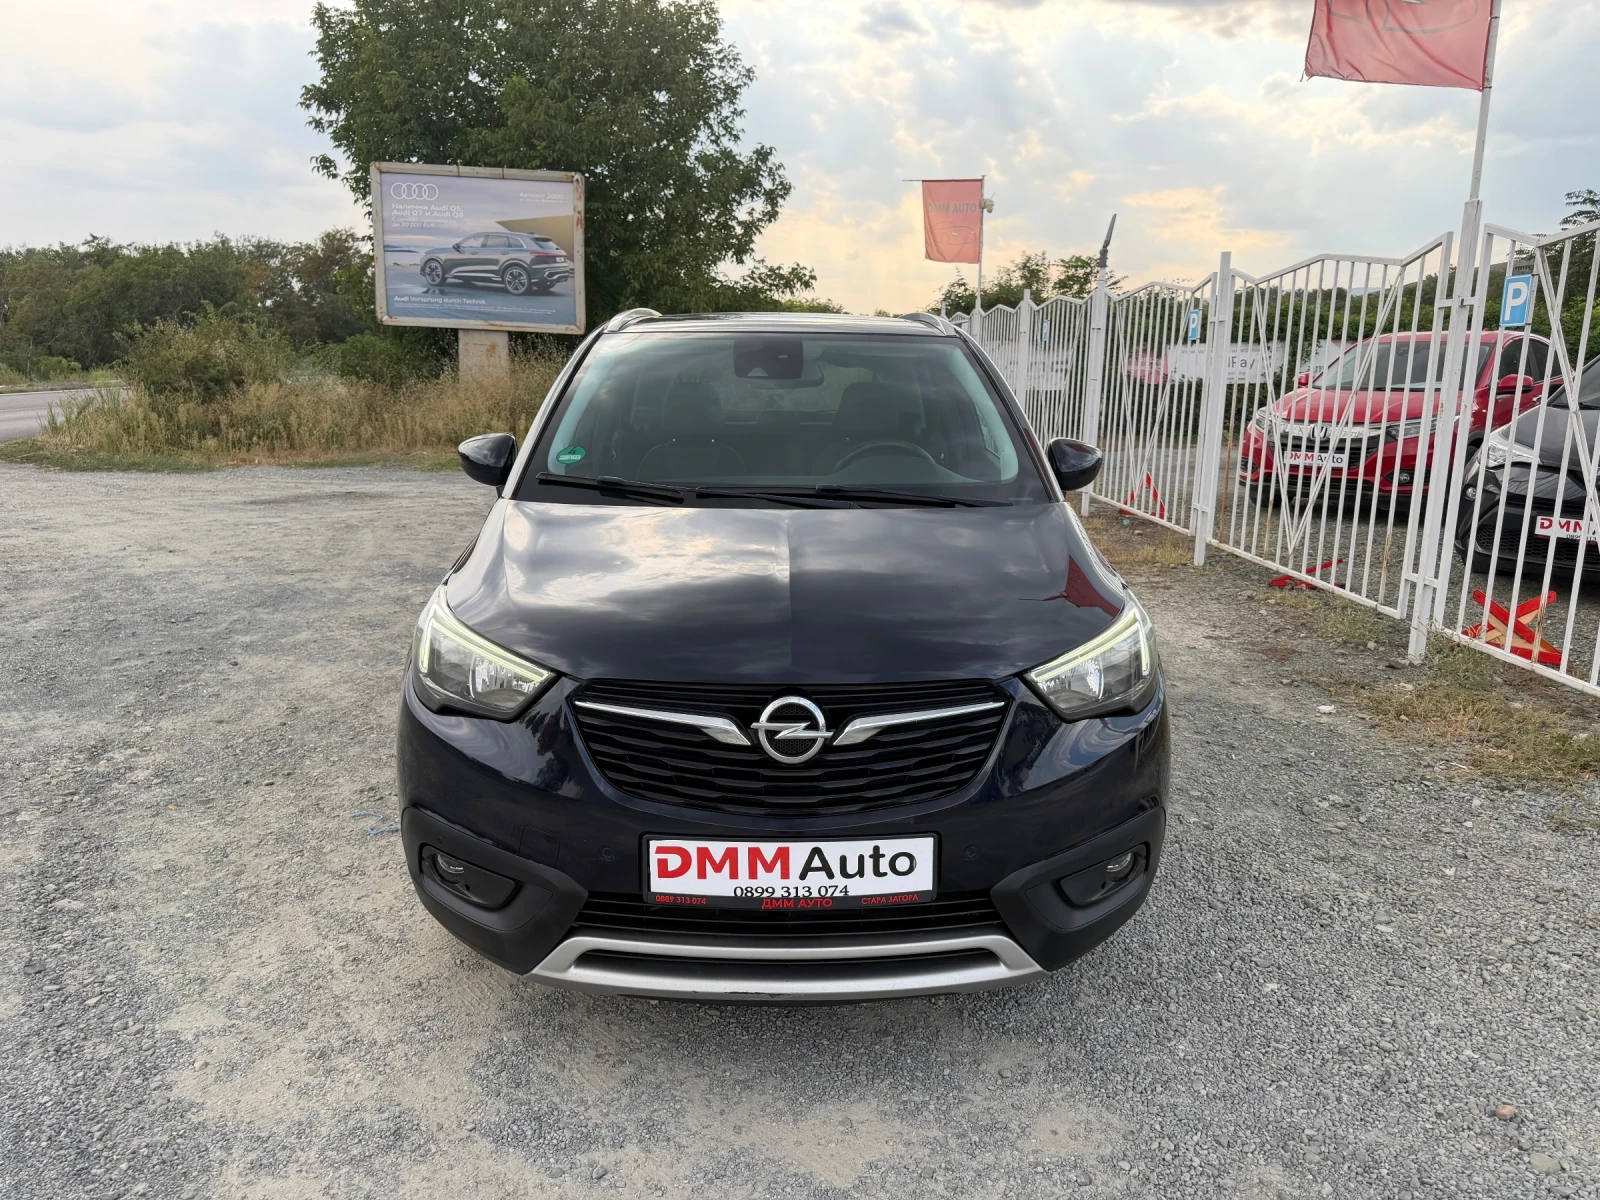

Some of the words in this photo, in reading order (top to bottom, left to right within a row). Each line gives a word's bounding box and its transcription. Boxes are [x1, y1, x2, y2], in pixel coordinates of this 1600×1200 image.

[928, 204, 950, 213] DMM
[952, 203, 977, 213] AUTO
[1504, 282, 1528, 321] P
[1190, 313, 1198, 337] P
[1317, 454, 1343, 464] Ato
[655, 846, 790, 880] DMM
[799, 845, 918, 881] Auto
[733, 886, 775, 897] 0899
[781, 886, 812, 897] 313
[818, 885, 850, 897] 074
[692, 897, 706, 905] 074
[762, 898, 795, 909] ДММ
[798, 898, 833, 908] АУТО
[861, 897, 887, 905] СТАРА
[888, 894, 919, 903] ЗАГОРА
